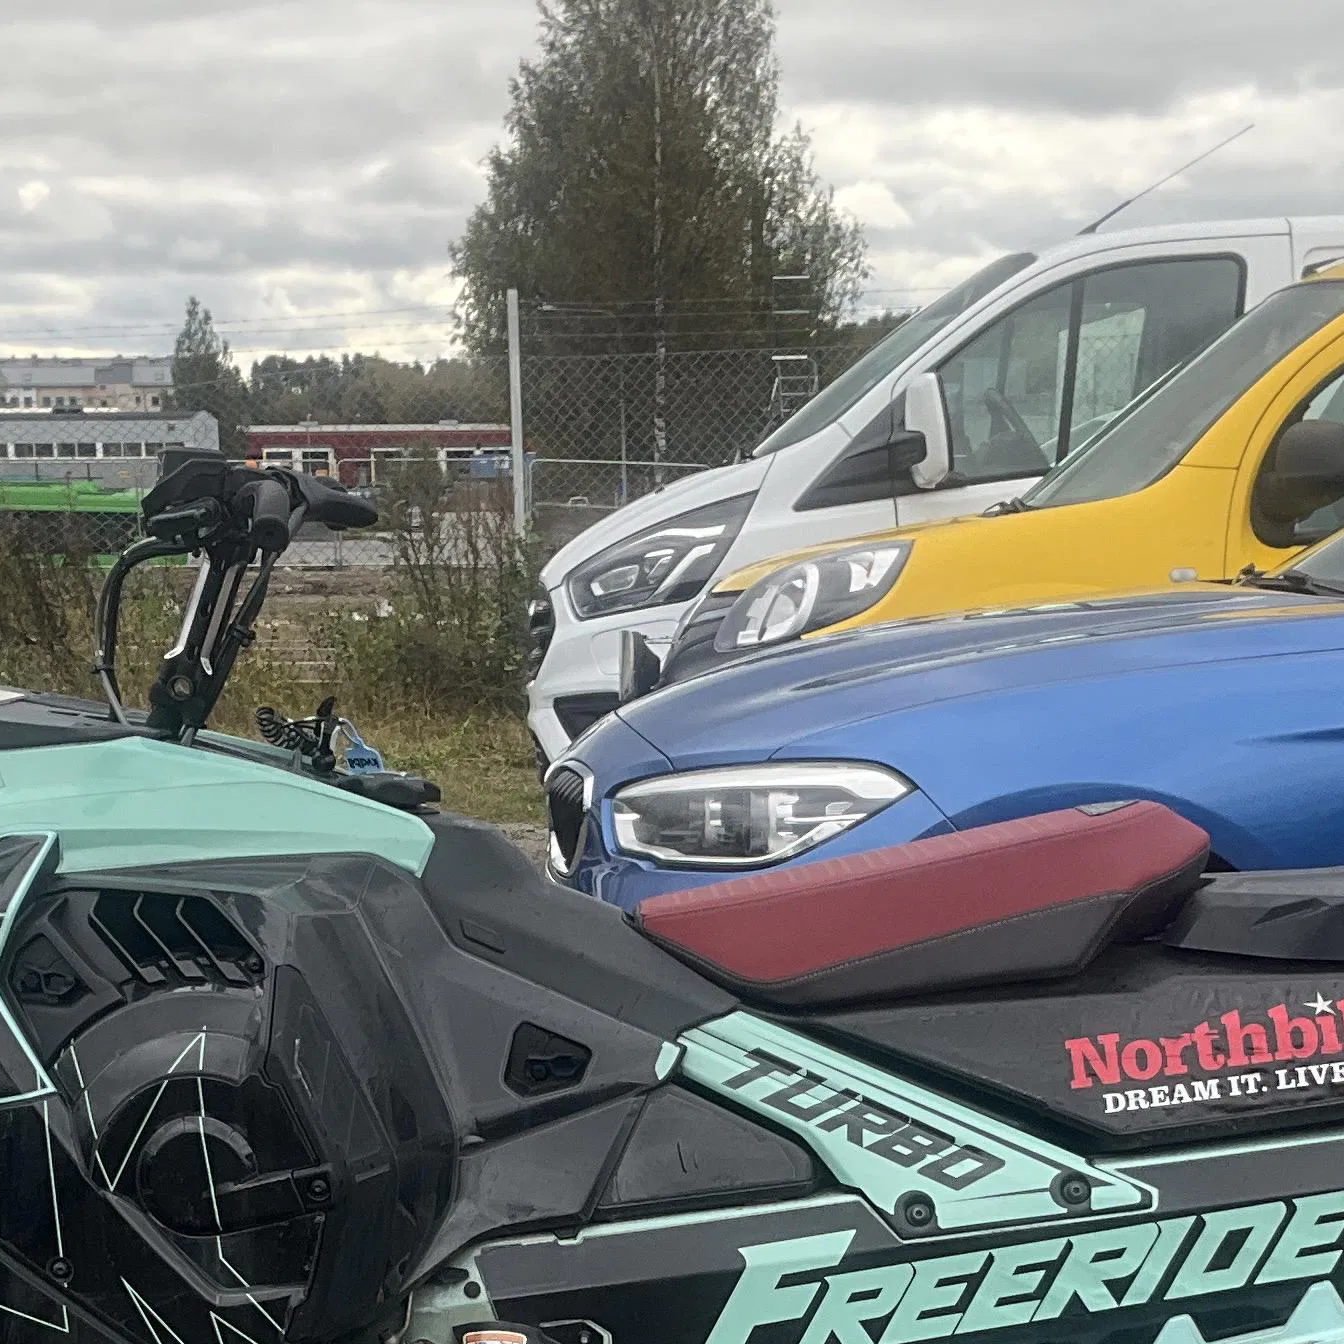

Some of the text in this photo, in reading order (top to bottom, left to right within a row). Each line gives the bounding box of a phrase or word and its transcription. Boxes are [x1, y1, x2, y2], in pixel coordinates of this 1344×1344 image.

[719, 1046, 1009, 1192] TURBO
[1103, 1078, 1221, 1114] DREAM
[1227, 1073, 1269, 1098] IT.
